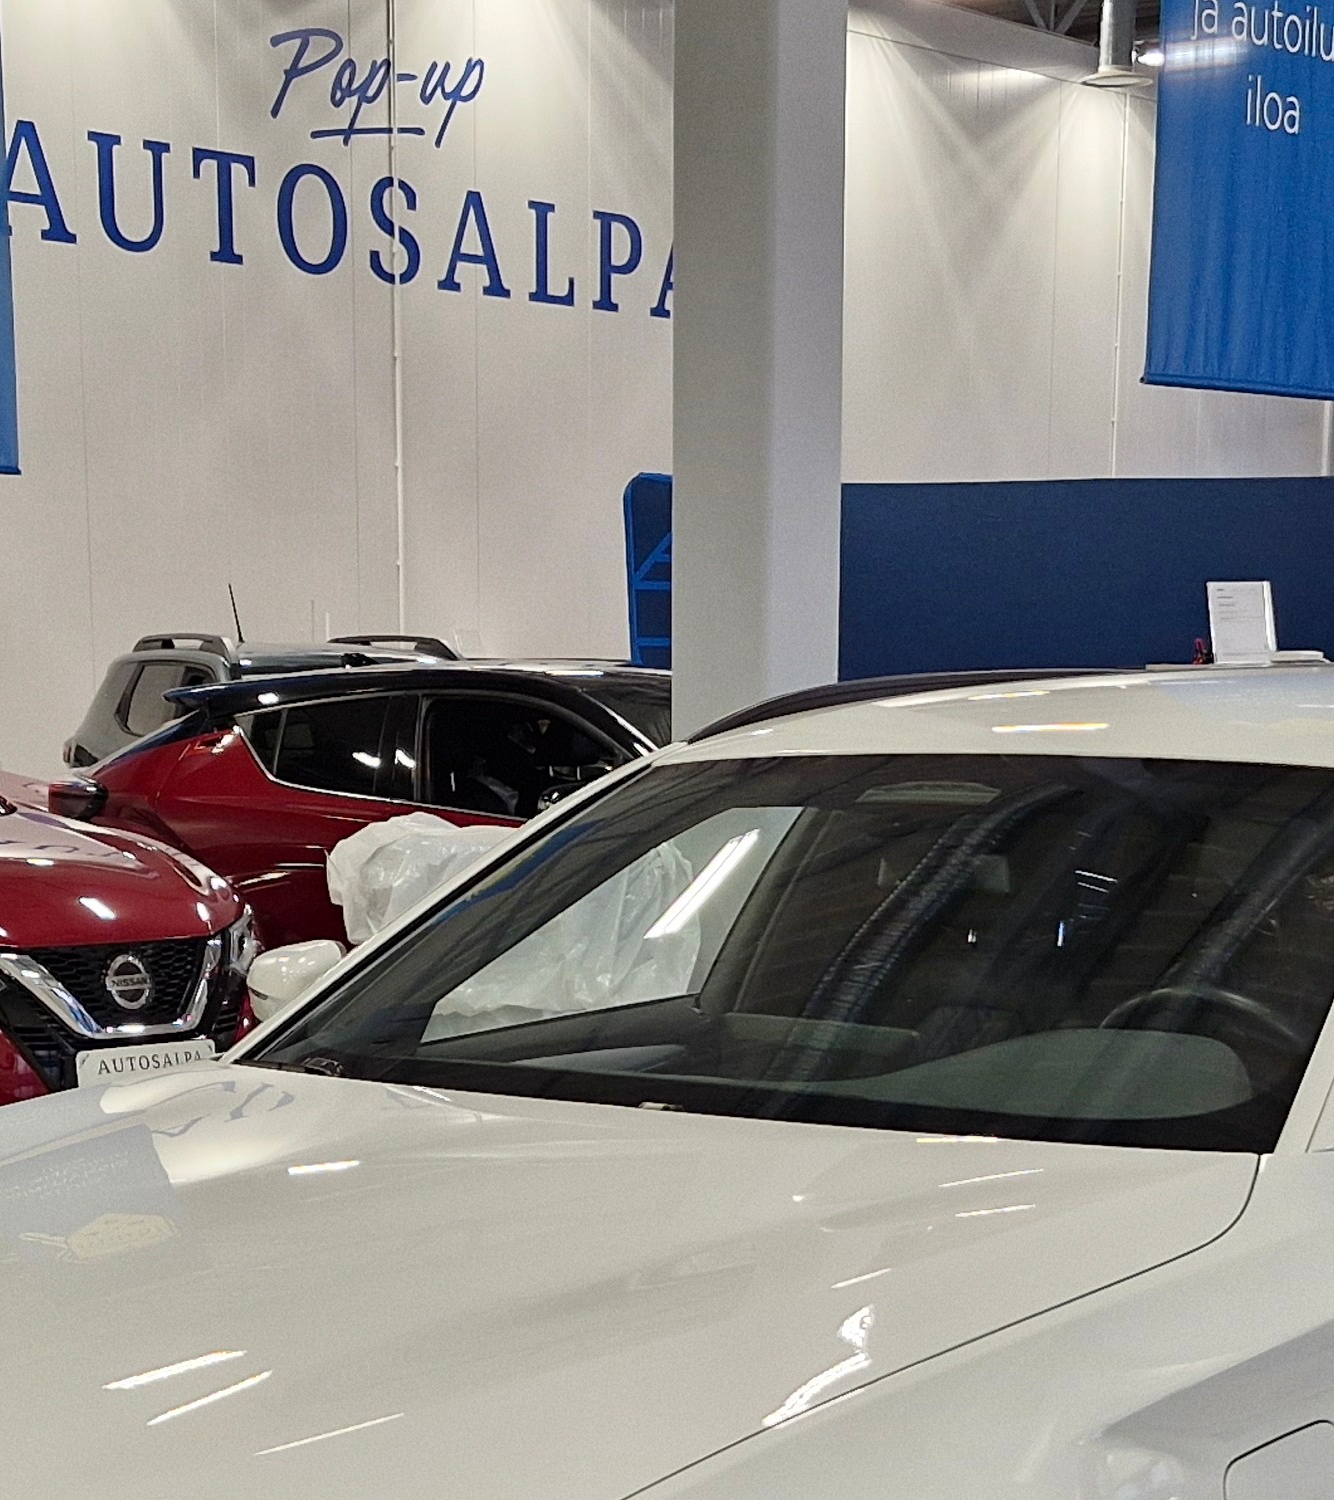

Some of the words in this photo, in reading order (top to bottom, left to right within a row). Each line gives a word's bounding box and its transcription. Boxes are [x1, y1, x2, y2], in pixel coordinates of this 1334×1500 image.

[269, 27, 485, 148] Pop-up
[1245, 73, 1301, 135] iloa
[5, 118, 674, 320] AUTOSALP
